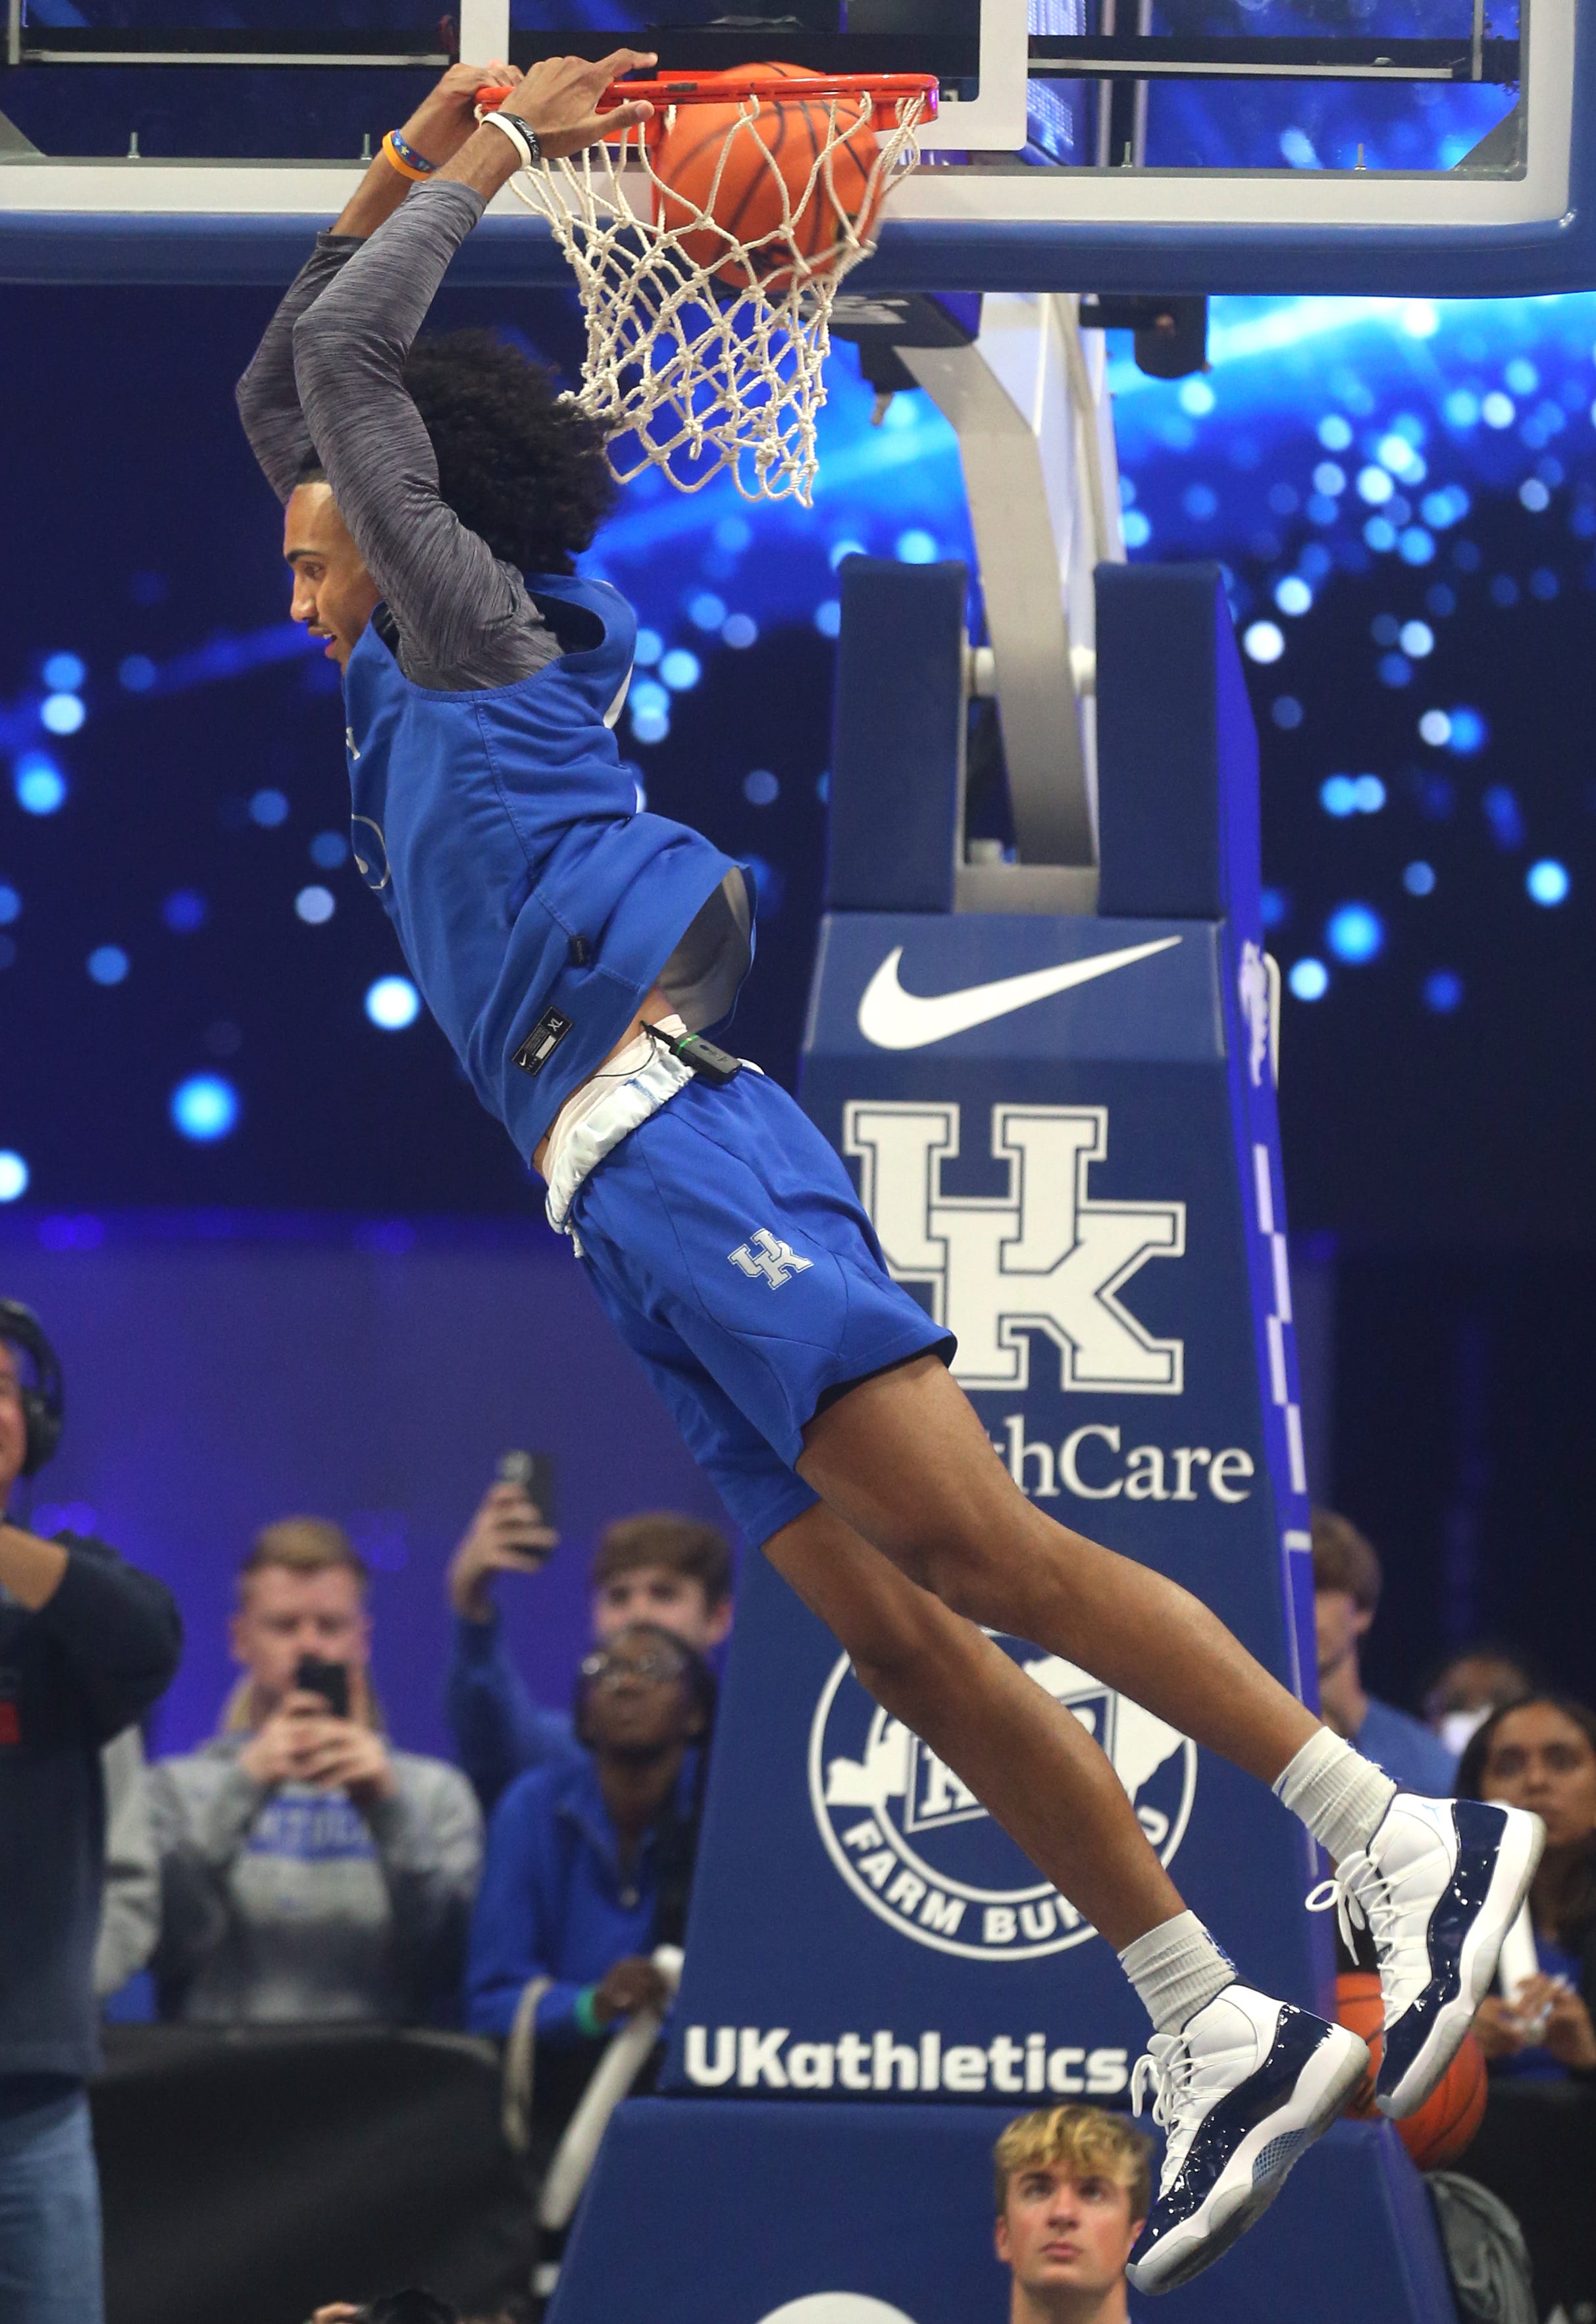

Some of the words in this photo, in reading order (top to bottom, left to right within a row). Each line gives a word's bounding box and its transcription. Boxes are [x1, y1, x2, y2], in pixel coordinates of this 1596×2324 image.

[548, 1018, 563, 1032] XL
[727, 1228, 814, 1290] UK
[843, 1101, 1185, 1394] UK
[843, 1819, 967, 1936] FARM
[684, 2025, 1158, 2094] UKathletics
